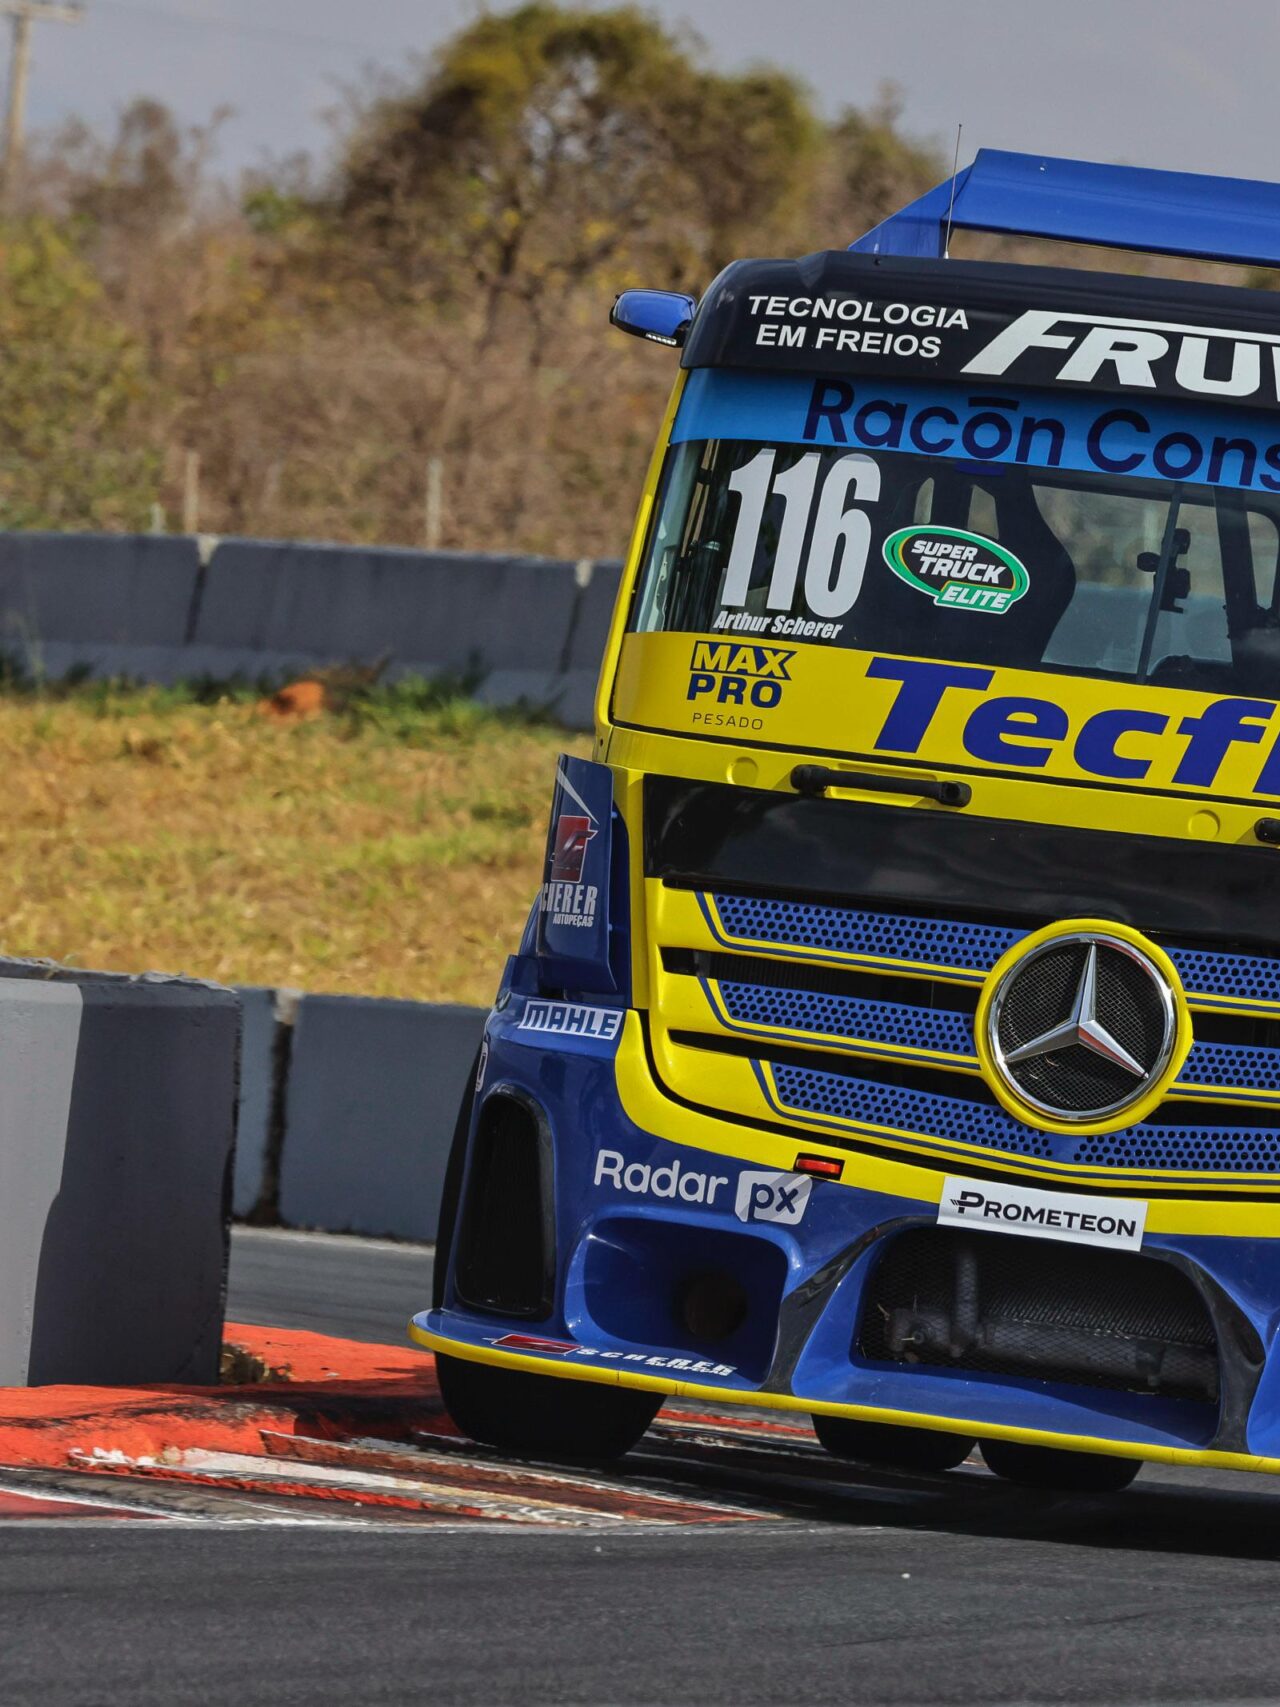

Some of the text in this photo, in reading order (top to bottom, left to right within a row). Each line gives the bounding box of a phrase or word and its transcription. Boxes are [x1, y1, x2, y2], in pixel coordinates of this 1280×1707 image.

[749, 296, 969, 330] TECNOLOGIA
[755, 324, 942, 358] EM FREIOS
[721, 448, 881, 618] 116
[911, 540, 978, 561] SUPER
[919, 556, 1007, 584] TRUCK
[941, 586, 1011, 609] ELITE
[713, 610, 843, 639] Arthur Scherer
[692, 642, 790, 678] MAX
[687, 673, 782, 708] PRO
[693, 712, 763, 730] PESADO
[540, 882, 598, 915] CHERER
[552, 913, 595, 928] AUTOPEÇAS
[521, 1002, 621, 1038] MAHLE
[594, 1149, 798, 1222] Radar px
[950, 1191, 1136, 1237] PROMETEON
[576, 1348, 738, 1377] SCHERER
